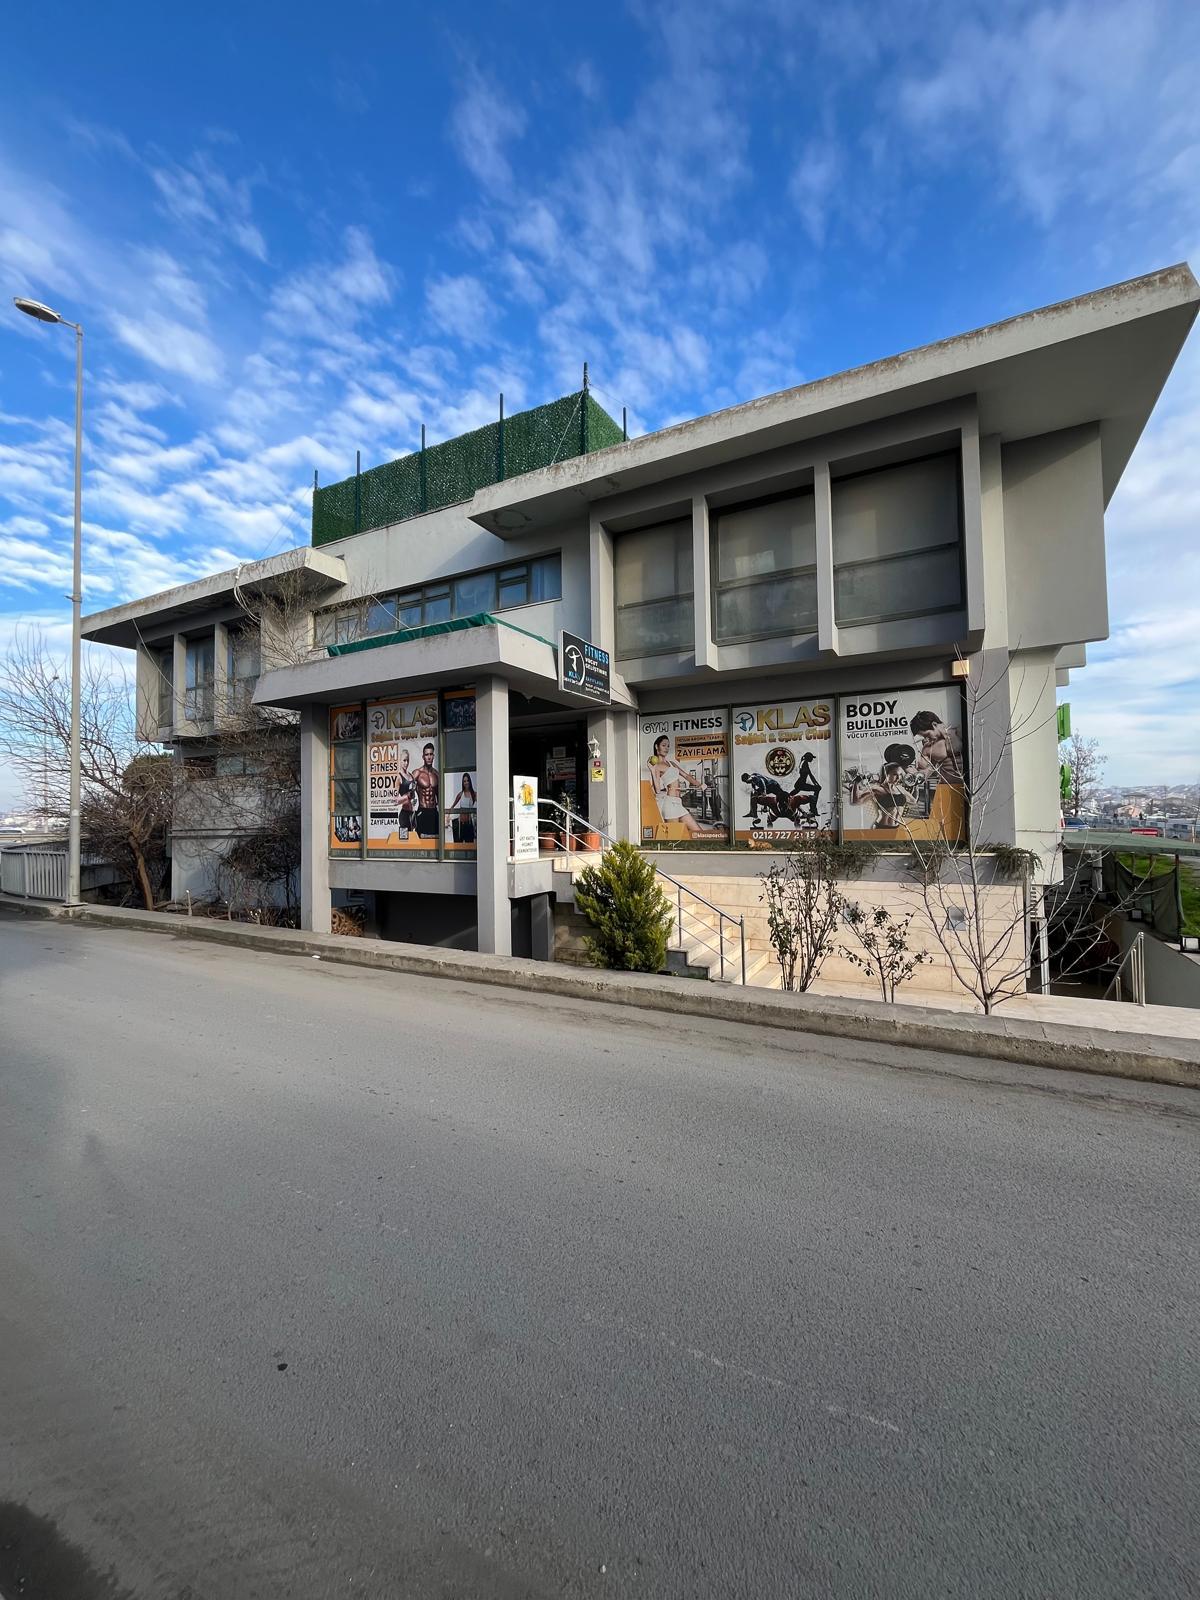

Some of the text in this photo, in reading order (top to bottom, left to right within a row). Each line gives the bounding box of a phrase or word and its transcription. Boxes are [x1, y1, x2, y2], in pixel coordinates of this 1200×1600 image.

[584, 644, 609, 665] FITNESS
[386, 704, 438, 729] KLAS
[846, 700, 898, 718] BODY
[757, 704, 831, 731] KLAS
[643, 721, 669, 734] GYM
[778, 731, 804, 742] Spor
[370, 744, 398, 762] GYM
[677, 747, 726, 757] ZAYIFLAMA
[370, 776, 398, 789] BODY
[752, 831, 773, 839] 0212
[774, 831, 791, 839] 727
